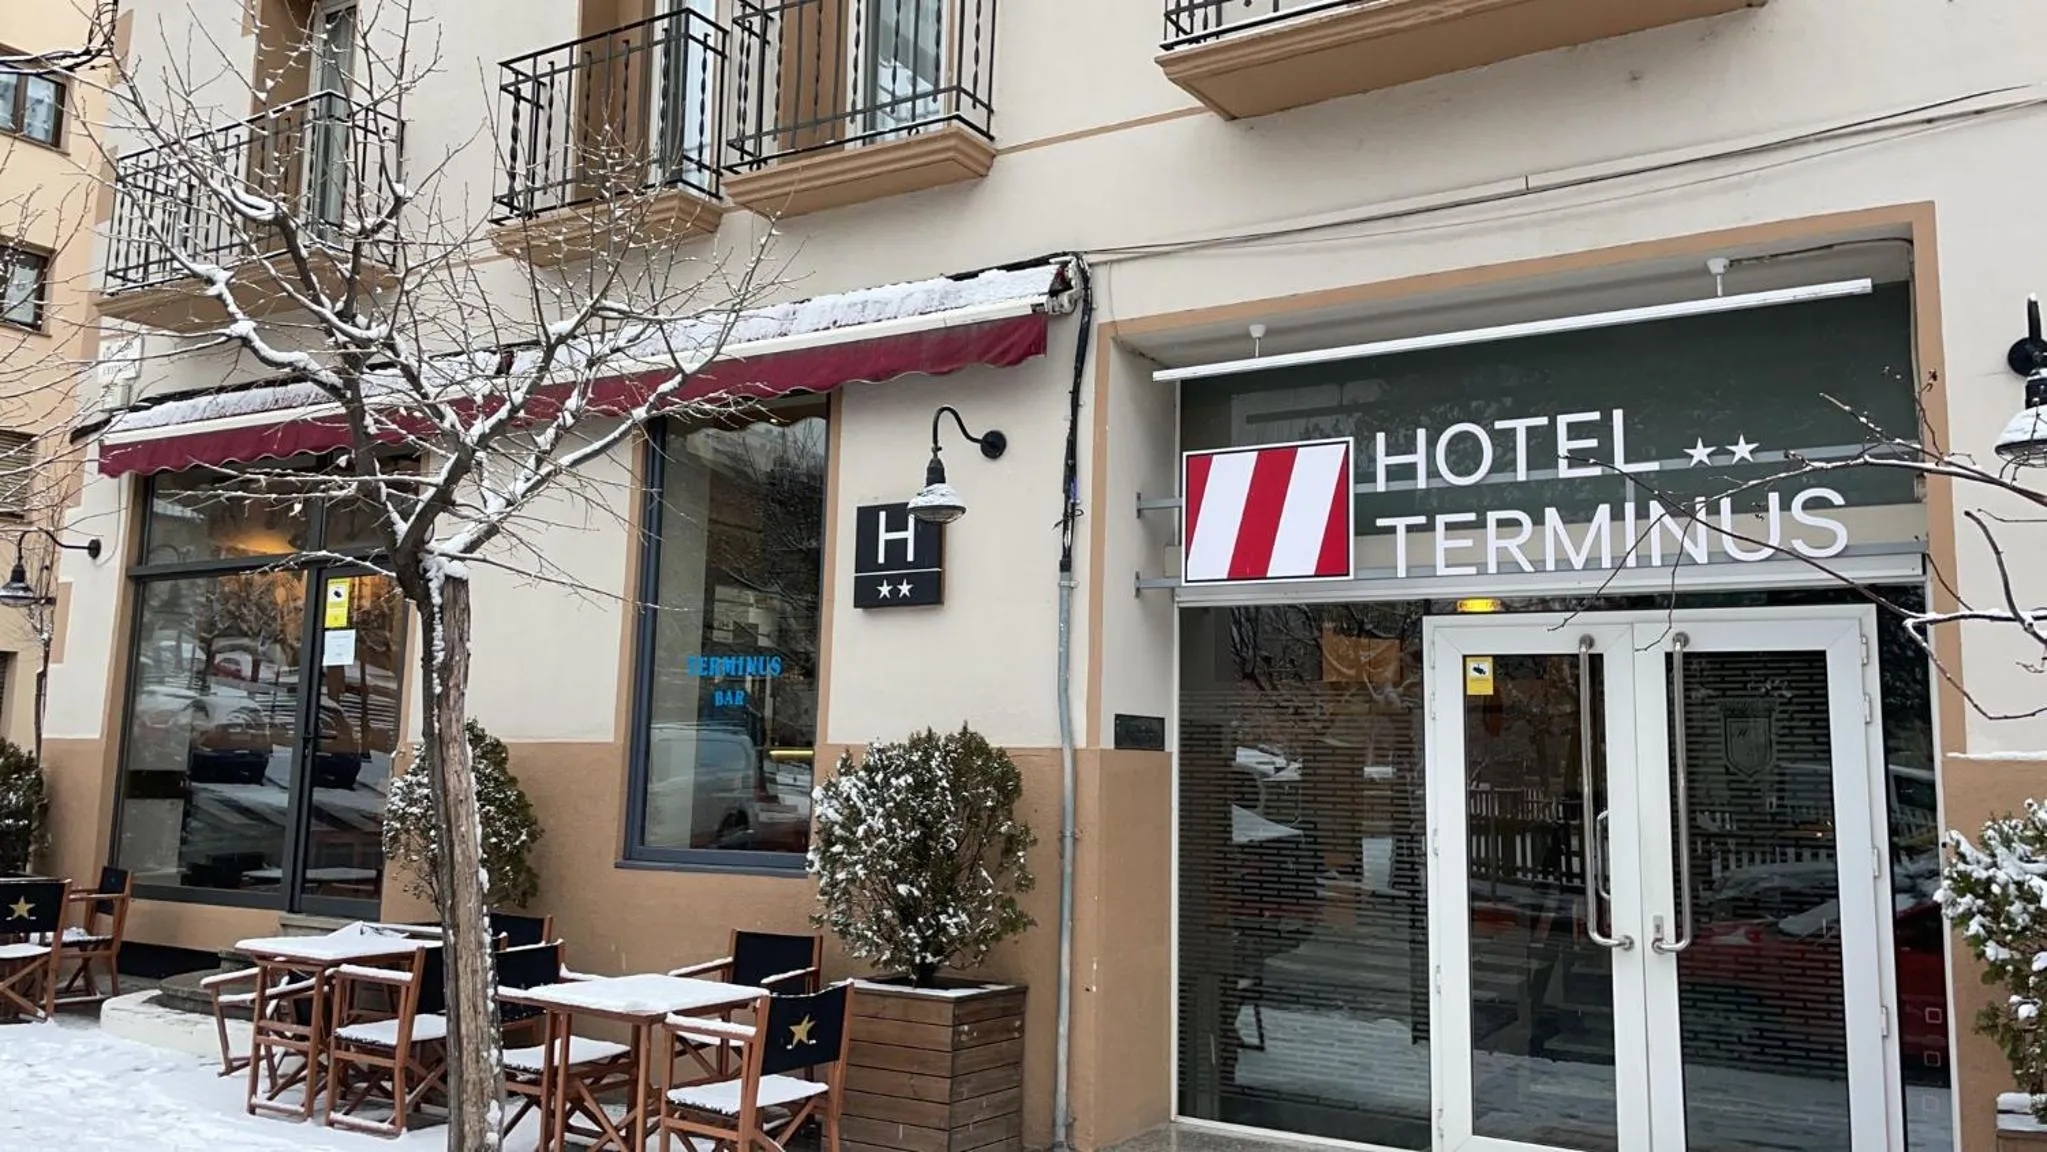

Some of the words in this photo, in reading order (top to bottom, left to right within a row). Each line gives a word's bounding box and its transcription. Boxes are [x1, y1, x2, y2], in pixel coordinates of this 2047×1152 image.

[1376, 408, 1660, 492] HOTEL
[877, 510, 915, 564] H
[1376, 488, 1848, 578] TERMINUS
[687, 655, 782, 677] TERMINUS
[714, 689, 745, 706] BAR
